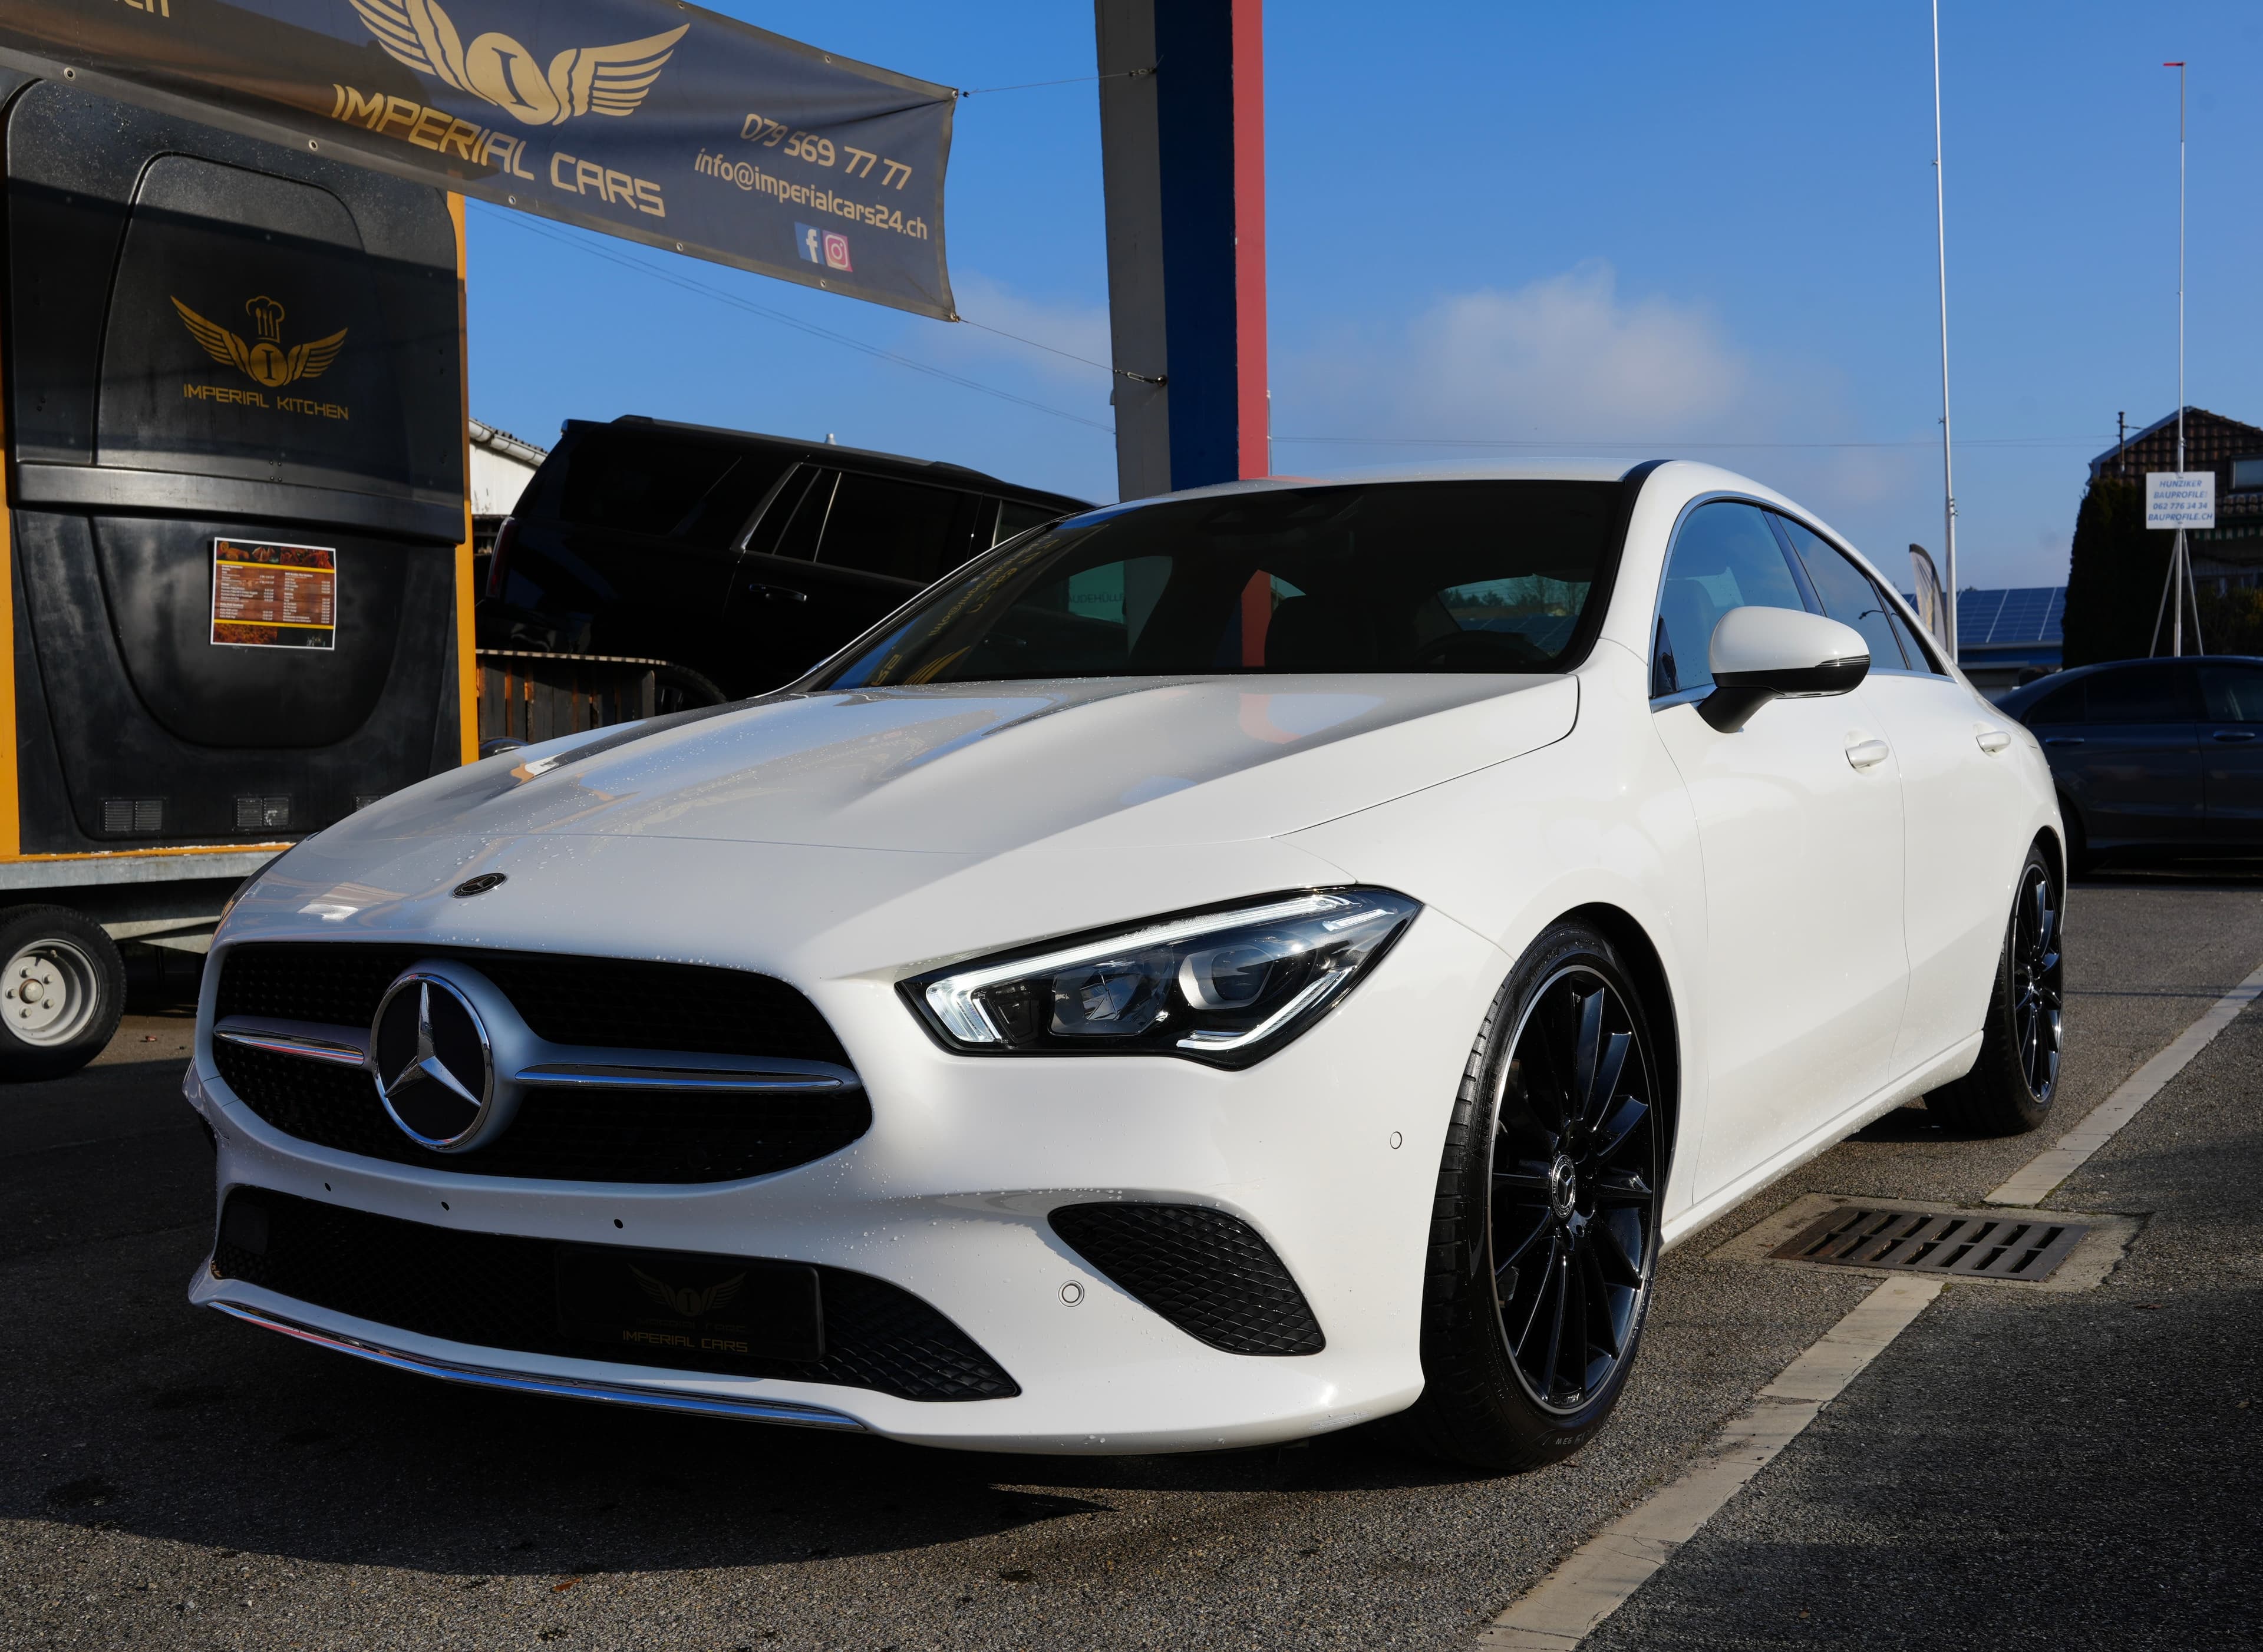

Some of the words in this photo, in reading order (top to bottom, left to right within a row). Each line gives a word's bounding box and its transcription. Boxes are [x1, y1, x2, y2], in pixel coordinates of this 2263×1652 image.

[332, 84, 534, 180] IMPERIAL
[550, 152, 665, 217] CARS
[740, 113, 789, 147] 079
[784, 131, 836, 167] 569
[844, 146, 877, 179] 77
[881, 158, 912, 190] 77
[694, 148, 928, 240] info@imperialcars24.ch
[183, 384, 269, 408] IMPERIAL
[277, 396, 349, 420] KITCHEN
[2159, 480, 2202, 488] HUNZIKER
[622, 1330, 695, 1348] IMPERIAL
[701, 1338, 750, 1353] CARS
